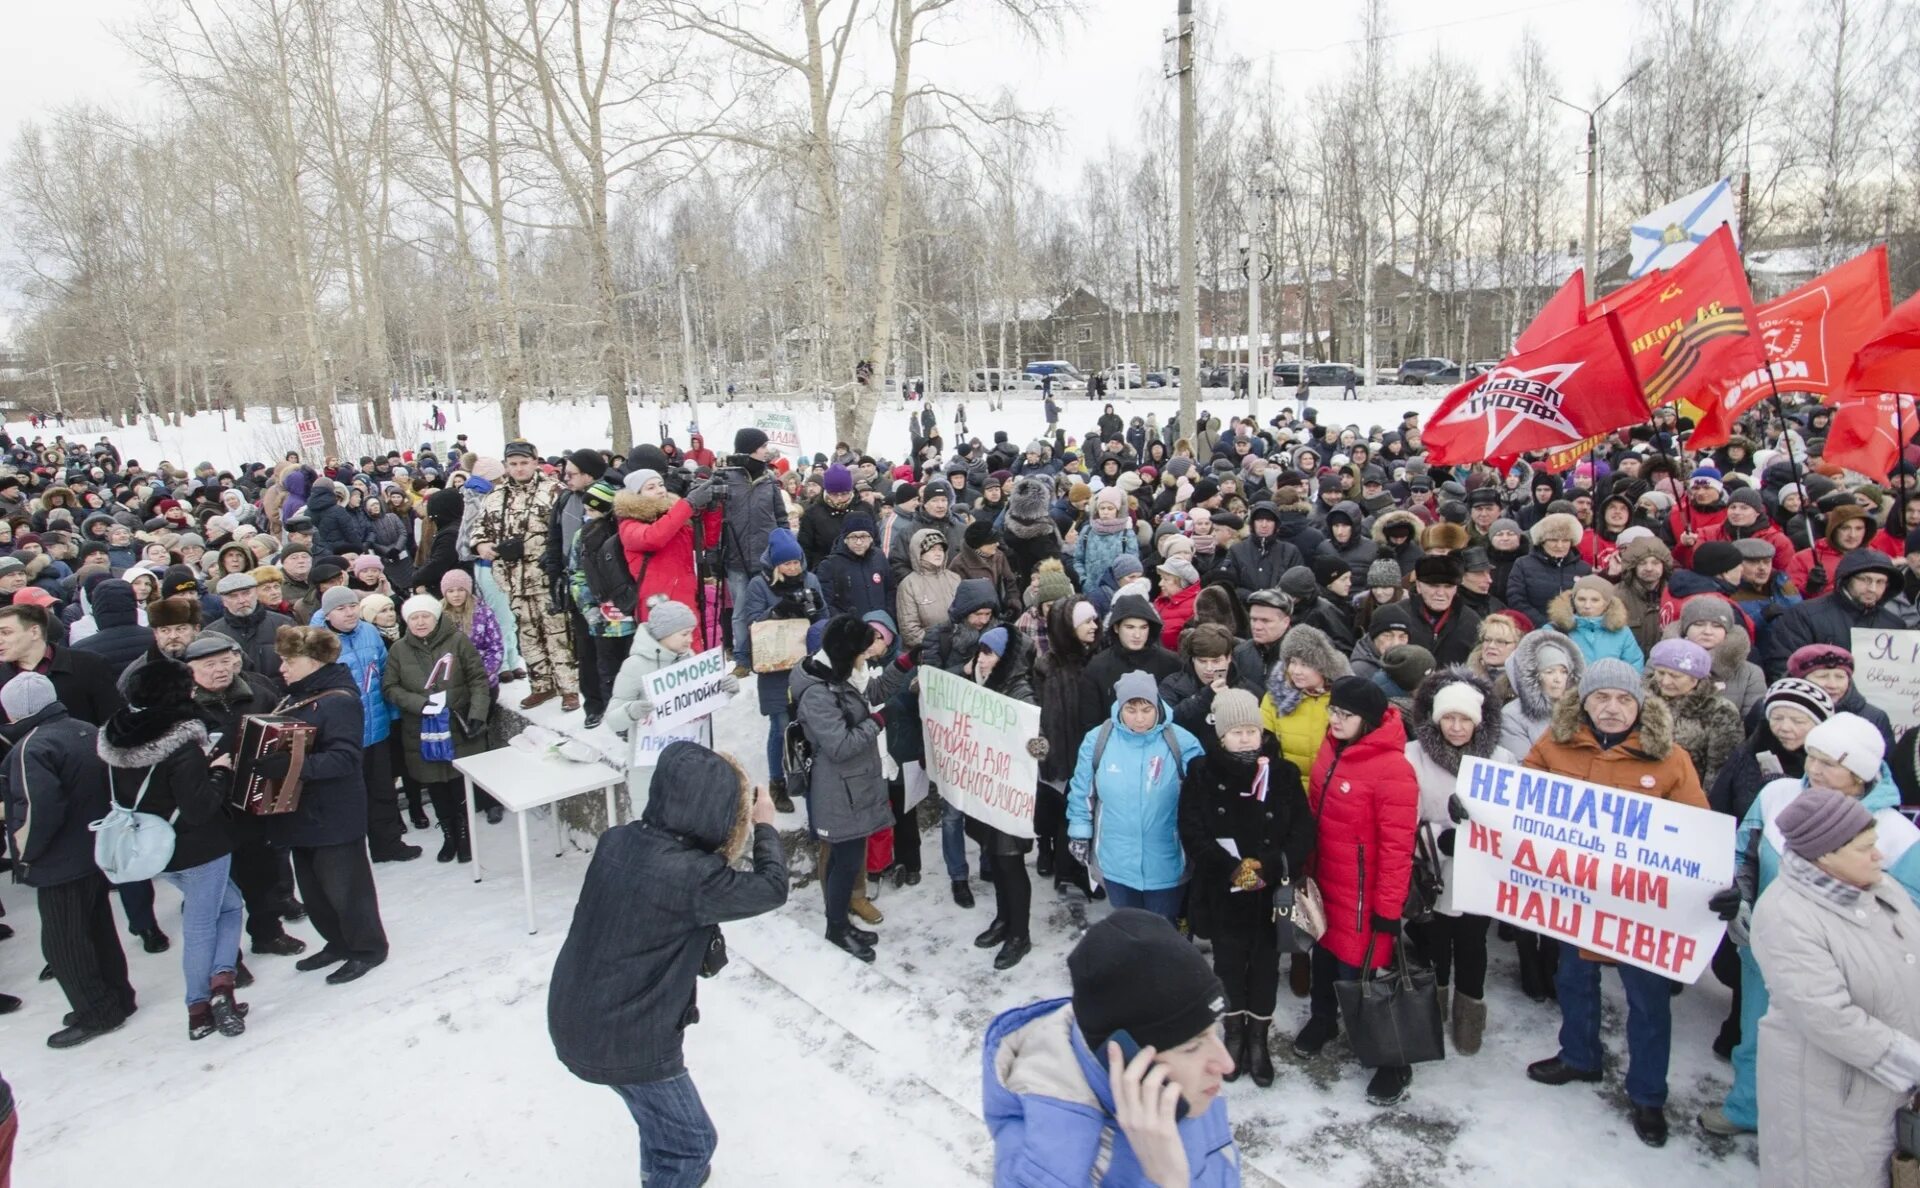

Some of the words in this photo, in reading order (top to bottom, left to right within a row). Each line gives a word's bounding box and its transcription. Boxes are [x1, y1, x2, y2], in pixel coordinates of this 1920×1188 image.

[298, 421, 317, 432] НЕТ
[1868, 632, 1899, 661] Я
[653, 655, 721, 695] ПОМОРЬЕ
[927, 670, 959, 711] НАШ
[656, 701, 672, 719] НЕ
[674, 680, 725, 712] ПОМОЙКА
[953, 711, 972, 737] НЕ
[983, 747, 1011, 780] ДЛЯ
[1469, 763, 1514, 807] НЕ
[1515, 773, 1653, 841] МОЛЧИ
[1512, 814, 1605, 853] ПОПАДЁШЬ
[1615, 842, 1628, 858] В
[1468, 820, 1503, 860] НЕ
[1511, 838, 1600, 892] ДАЙ
[1611, 863, 1669, 910] ИМ
[1509, 868, 1592, 905] ОПУСТИТЬ
[1496, 880, 1582, 938] НАШ
[1591, 909, 1697, 974] СЕВЕР
